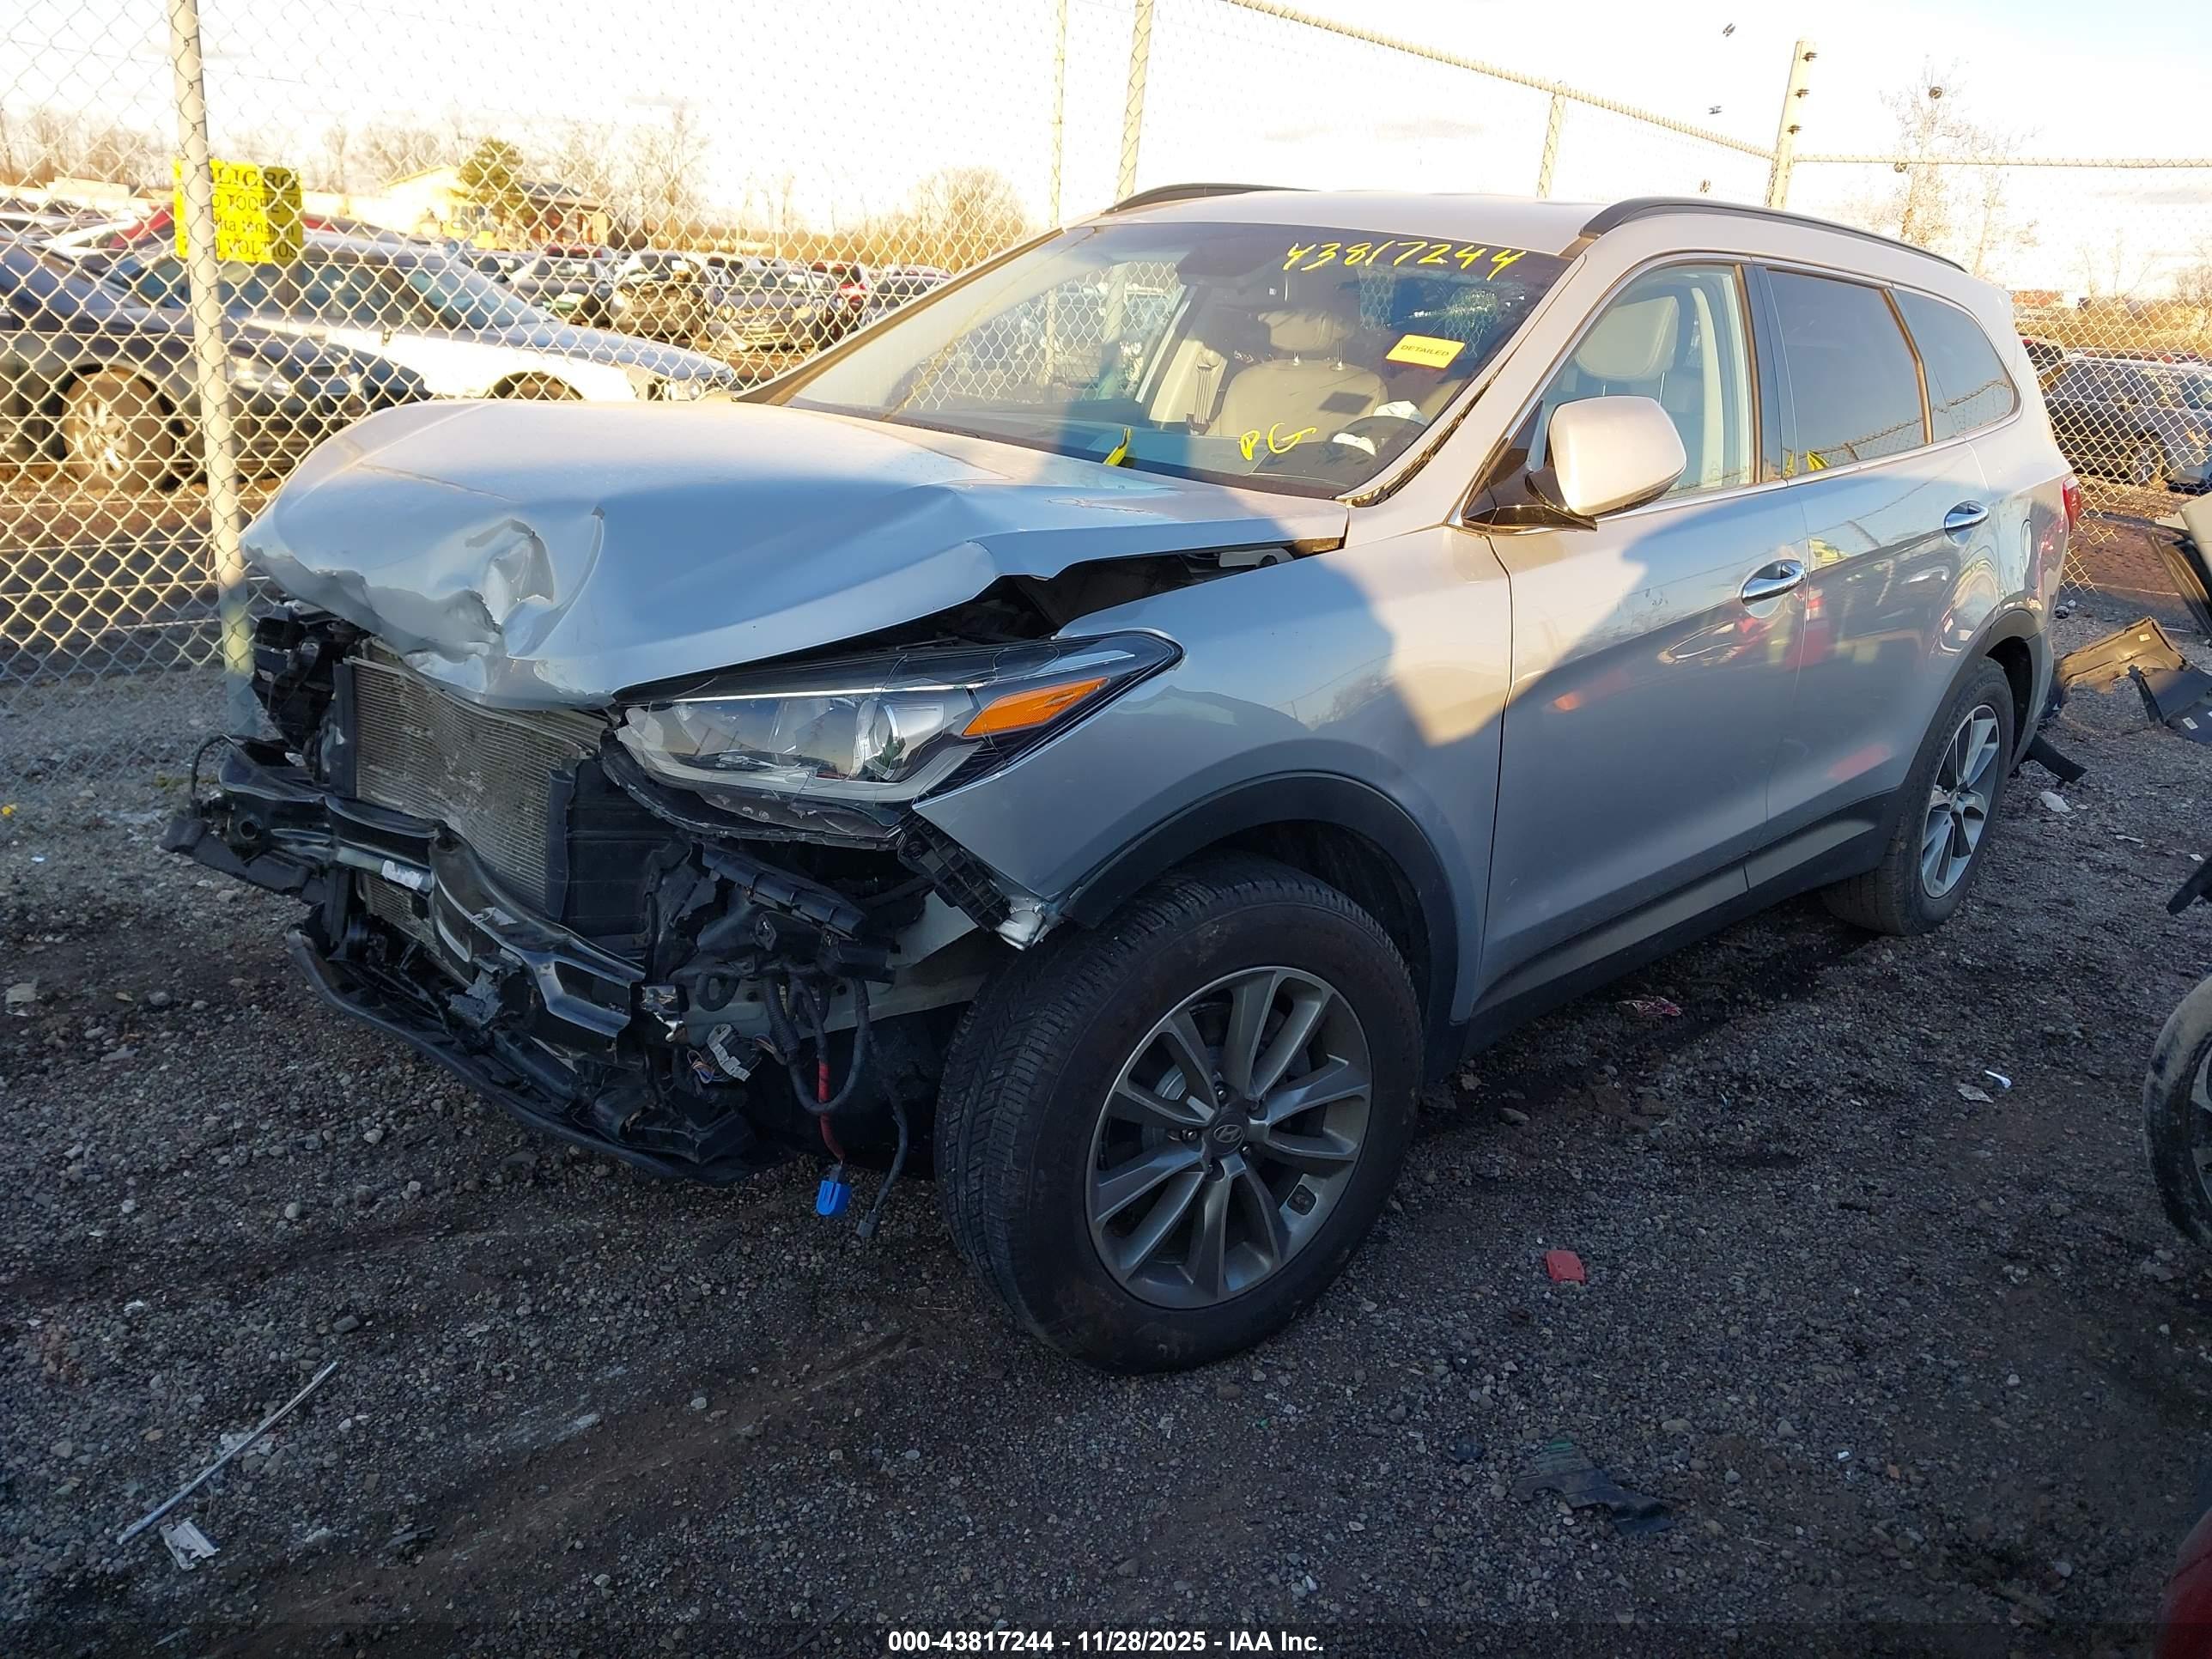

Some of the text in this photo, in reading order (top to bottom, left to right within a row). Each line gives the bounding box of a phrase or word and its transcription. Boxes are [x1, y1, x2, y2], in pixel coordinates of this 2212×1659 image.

[211, 167, 296, 191] LIGRO
[1283, 240, 1527, 281] 43817244
[1401, 344, 1449, 356] DETAILED
